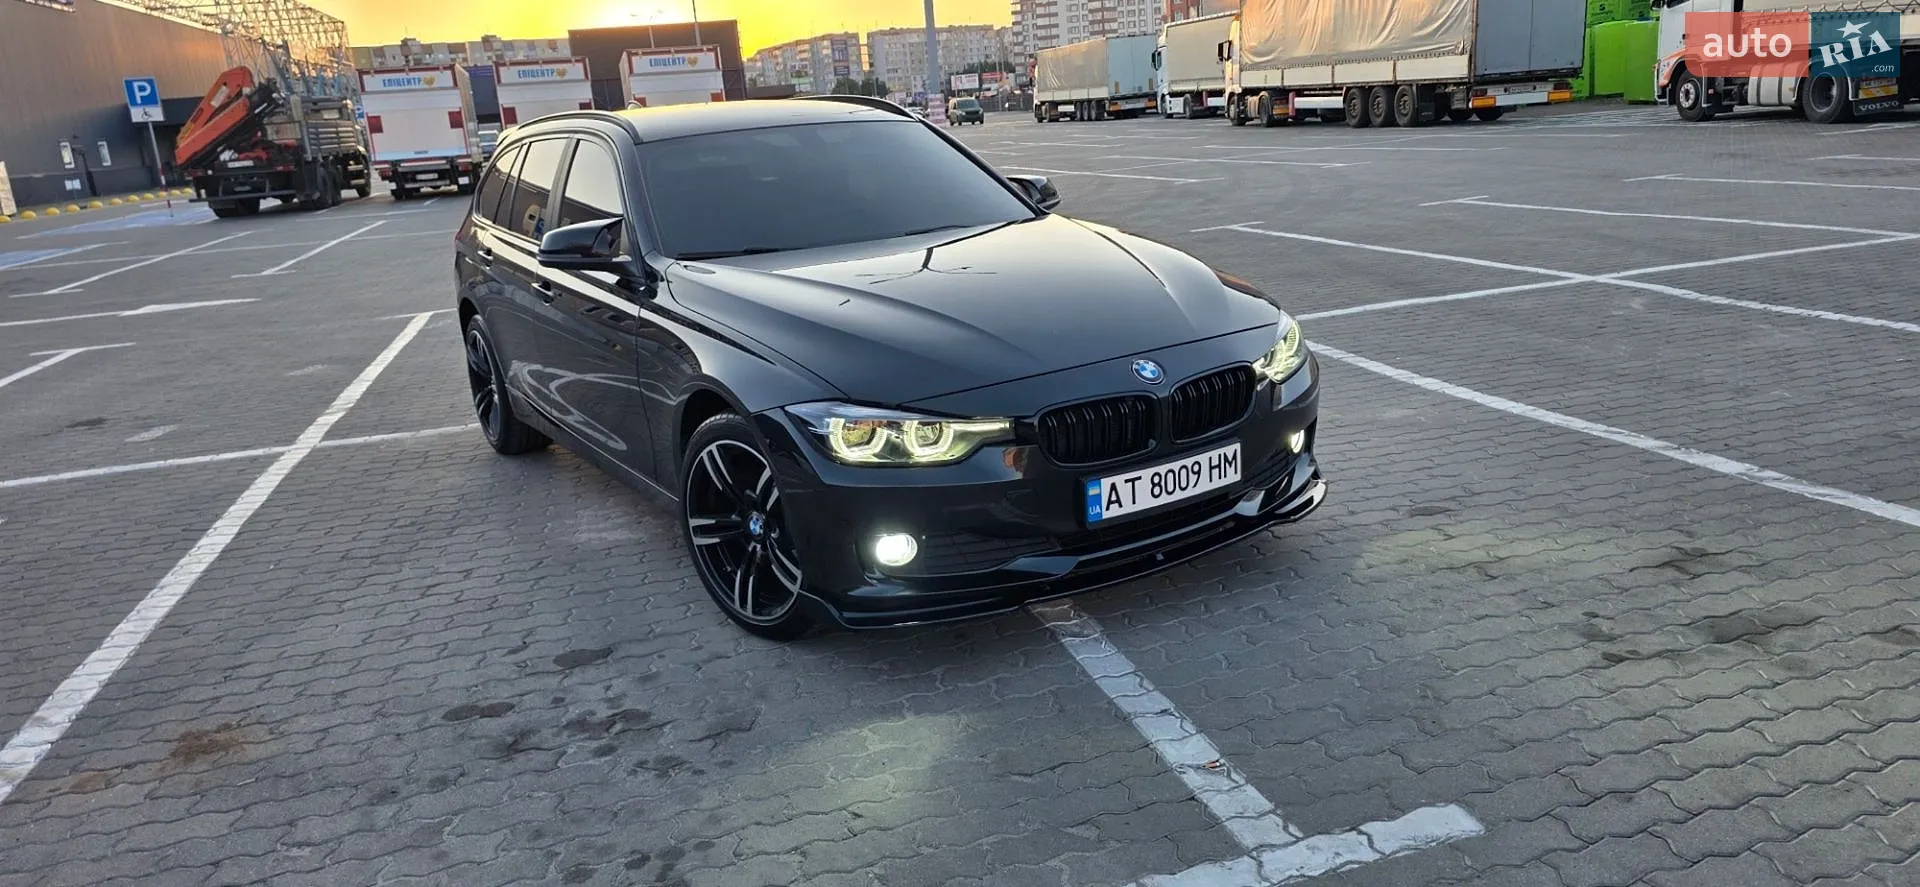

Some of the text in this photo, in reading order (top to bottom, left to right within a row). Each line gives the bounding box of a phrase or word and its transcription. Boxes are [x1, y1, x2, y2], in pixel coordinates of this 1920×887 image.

[132, 81, 151, 104] P
[1859, 100, 1900, 111] VOLVO
[1105, 448, 1238, 511] AT 8009 HM
[1089, 506, 1101, 515] UA
